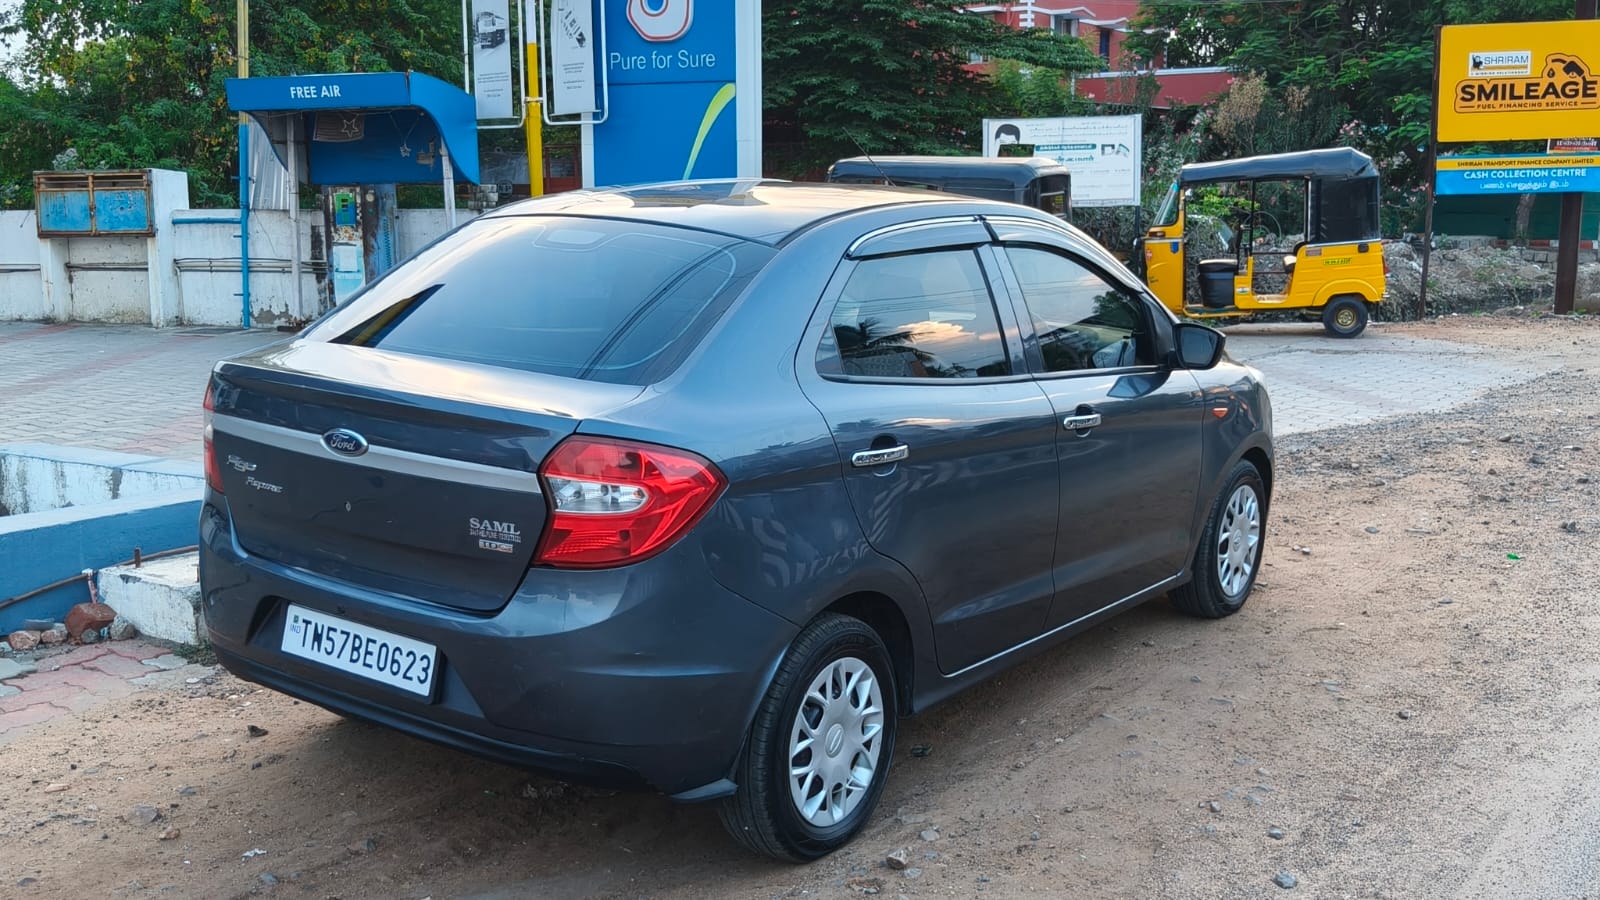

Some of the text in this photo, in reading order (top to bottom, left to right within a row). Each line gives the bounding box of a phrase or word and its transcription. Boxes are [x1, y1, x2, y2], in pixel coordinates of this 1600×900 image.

[610, 50, 716, 70] Pure for Sure
[1484, 55, 1529, 65] SHRIRAM
[289, 84, 342, 99] FREE AIR
[1460, 80, 1598, 102] SMILEAGE
[1463, 168, 1587, 179] CASH COLLECTION CENTRE
[330, 434, 356, 450] Ford
[469, 517, 521, 536] SAML
[302, 618, 431, 685] TN57BE0623
